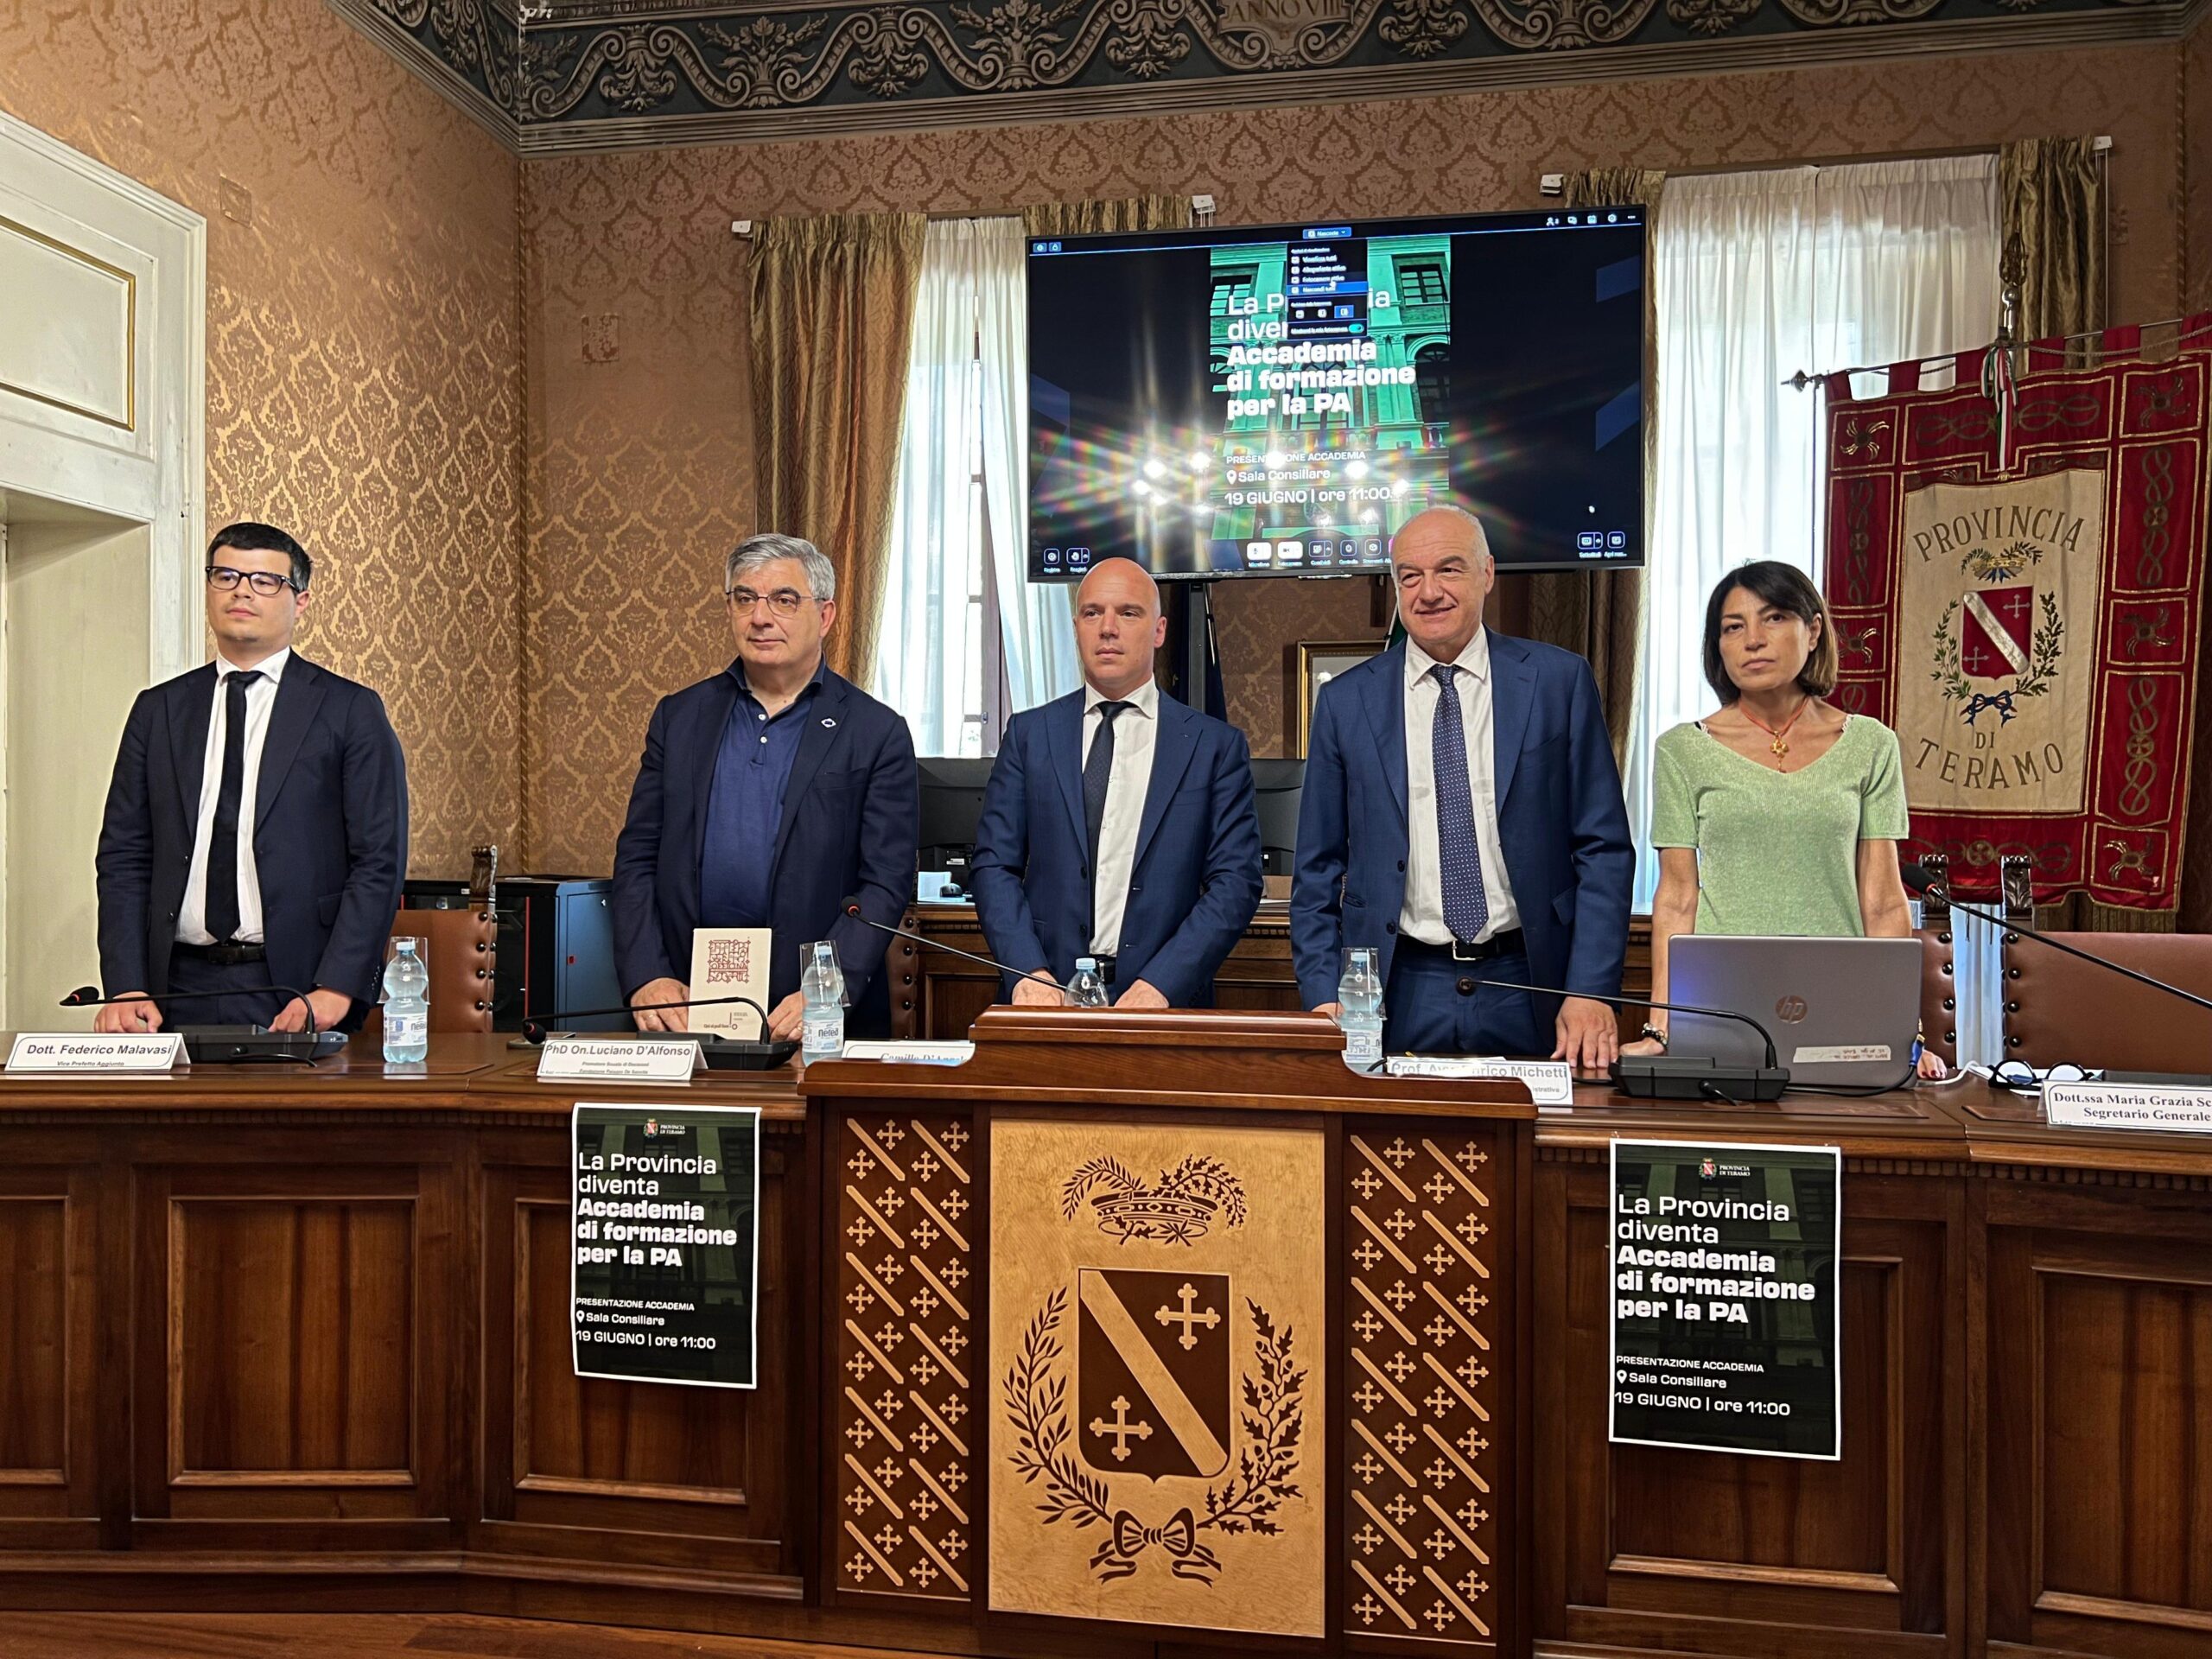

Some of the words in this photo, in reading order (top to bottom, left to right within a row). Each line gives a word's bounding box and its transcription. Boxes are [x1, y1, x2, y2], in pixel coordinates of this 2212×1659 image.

[1228, 296, 1259, 315] La
[1228, 320, 1288, 340] dive
[1227, 339, 1376, 366] Accademia
[1227, 370, 1252, 391] di
[1258, 365, 1416, 390] formazione
[1227, 397, 1276, 421] per
[1281, 394, 1306, 415] la
[1314, 392, 1351, 415] PA
[1308, 451, 1366, 461] ACCADEMIA
[1238, 471, 1265, 482] Sala
[1268, 469, 1331, 480] Consiliare
[1224, 492, 1244, 505] 19
[1246, 490, 1307, 505] GIUGNO
[1319, 490, 1345, 502] ore
[1349, 487, 1390, 500] 11:00
[1912, 505, 2085, 563] PROVINCIA
[1975, 732, 1994, 749] DI
[1915, 738, 2063, 790] TERAMO
[1780, 995, 1805, 1022] hp
[27, 1045, 55, 1054] Dott.
[60, 1045, 114, 1054] Federico
[117, 1045, 172, 1054] Malavasi
[546, 1045, 568, 1054] PhD
[636, 1046, 690, 1056] D'Alfonso
[1511, 1066, 1567, 1078] Michetti
[2054, 1092, 2103, 1103] Dott.ssa
[2107, 1094, 2145, 1105] Maria
[2150, 1096, 2193, 1107] Grazia
[2084, 1107, 2149, 1120] Segretario
[2152, 1109, 2211, 1122] Generale
[579, 1152, 604, 1171] La
[610, 1153, 717, 1175] Provincia
[578, 1174, 659, 1196] diventa
[577, 1198, 705, 1221] Accademia
[1618, 1194, 1649, 1215] La
[1659, 1196, 1789, 1221] Provincia
[577, 1220, 598, 1240] di
[603, 1221, 737, 1245] formazione
[1618, 1219, 1719, 1243] diventa
[577, 1245, 618, 1265] per
[623, 1245, 644, 1265] la
[650, 1247, 683, 1267] PA
[1617, 1245, 1776, 1273] Accademia
[1617, 1270, 1643, 1291] di
[1650, 1272, 1815, 1300] formazione
[575, 1297, 644, 1308] PRESENTAZIONE
[645, 1301, 695, 1311] ACCADEMIA
[1618, 1299, 1668, 1319] per
[1675, 1299, 1700, 1320] la
[1709, 1302, 1749, 1324] PA
[586, 1312, 609, 1323] Sala
[611, 1313, 664, 1325] Consiliare
[575, 1330, 591, 1341] 19
[594, 1332, 645, 1345] GIUGNO
[654, 1336, 677, 1347] ore
[680, 1337, 716, 1350] 11:00
[1617, 1356, 1700, 1369] PRESENTAZIONE
[1702, 1361, 1764, 1373] ACCADEMIA
[1629, 1372, 1657, 1384] Sala
[1661, 1374, 1726, 1389] Consiliare
[1614, 1392, 1634, 1404] 19
[1637, 1393, 1701, 1410] GIUGNO
[1713, 1400, 1743, 1412] ore
[1745, 1401, 1790, 1416] 11:00
